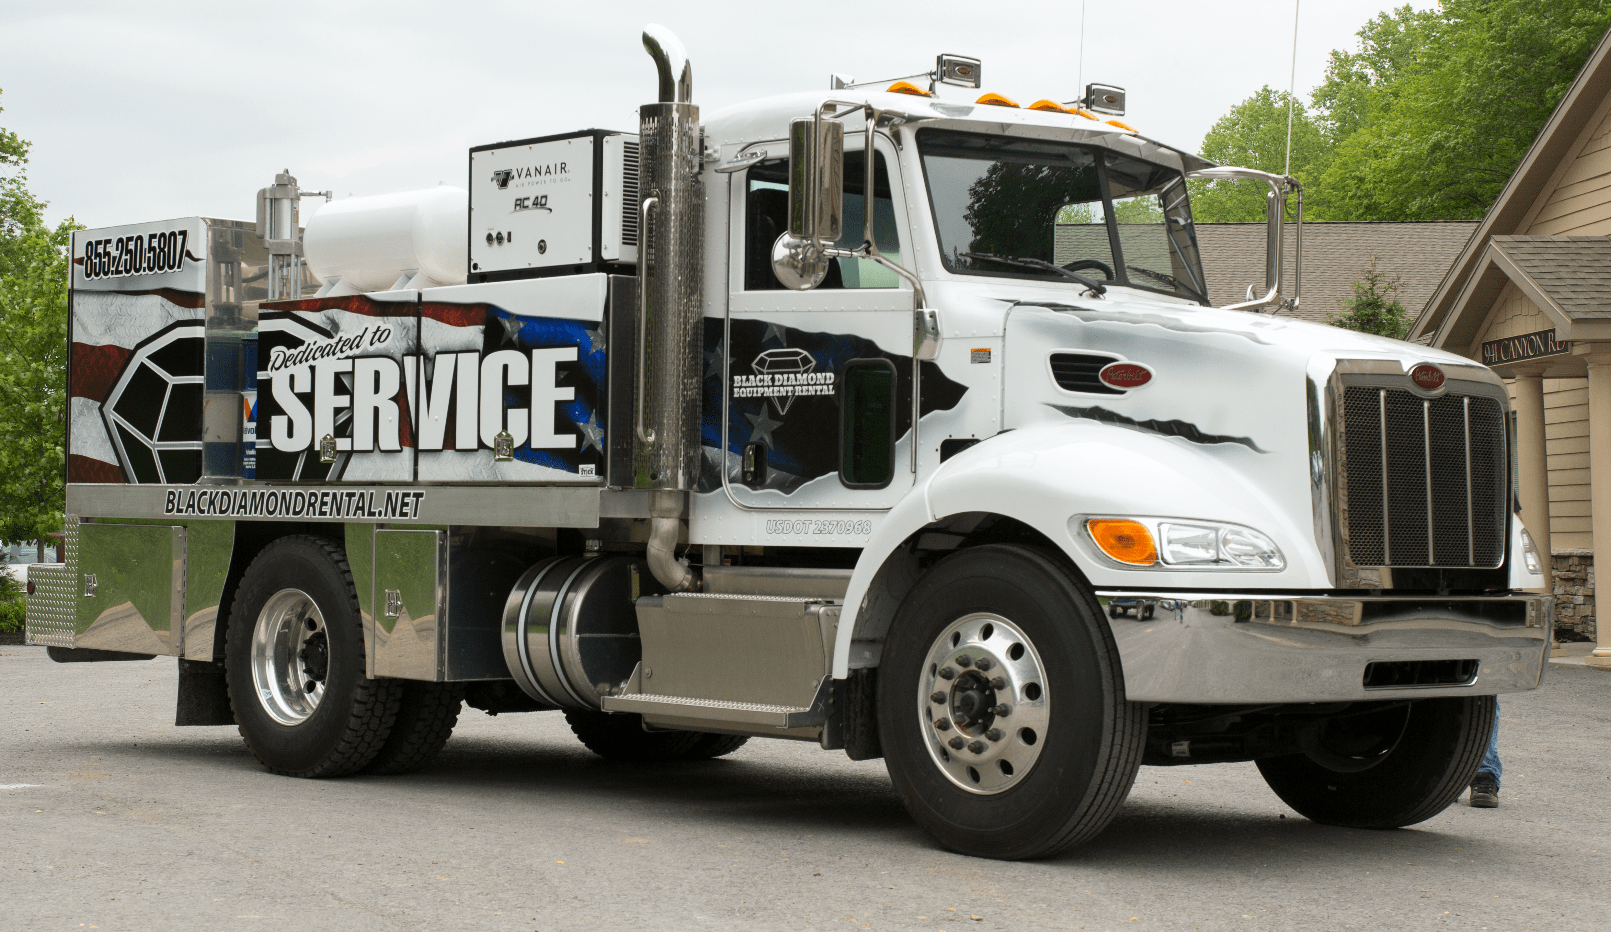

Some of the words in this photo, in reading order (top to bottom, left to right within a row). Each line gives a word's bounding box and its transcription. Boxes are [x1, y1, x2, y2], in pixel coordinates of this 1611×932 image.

[516, 162, 567, 179] VANAIR
[532, 194, 548, 207] 40
[84, 229, 189, 281] 855.250.5807
[269, 332, 365, 372] Dedicated
[369, 325, 392, 347] to
[1501, 332, 1545, 361] CANYON
[733, 374, 773, 387] BLACK
[774, 372, 835, 386] DIAMOND
[270, 346, 579, 452] SERVICE
[733, 386, 794, 398] EQUIPMENT
[794, 385, 835, 396] RENTAL
[164, 489, 426, 519] BLACKDIAMONDRENTAL.NET
[766, 519, 812, 535] USDOT
[813, 519, 872, 535] 2370968
